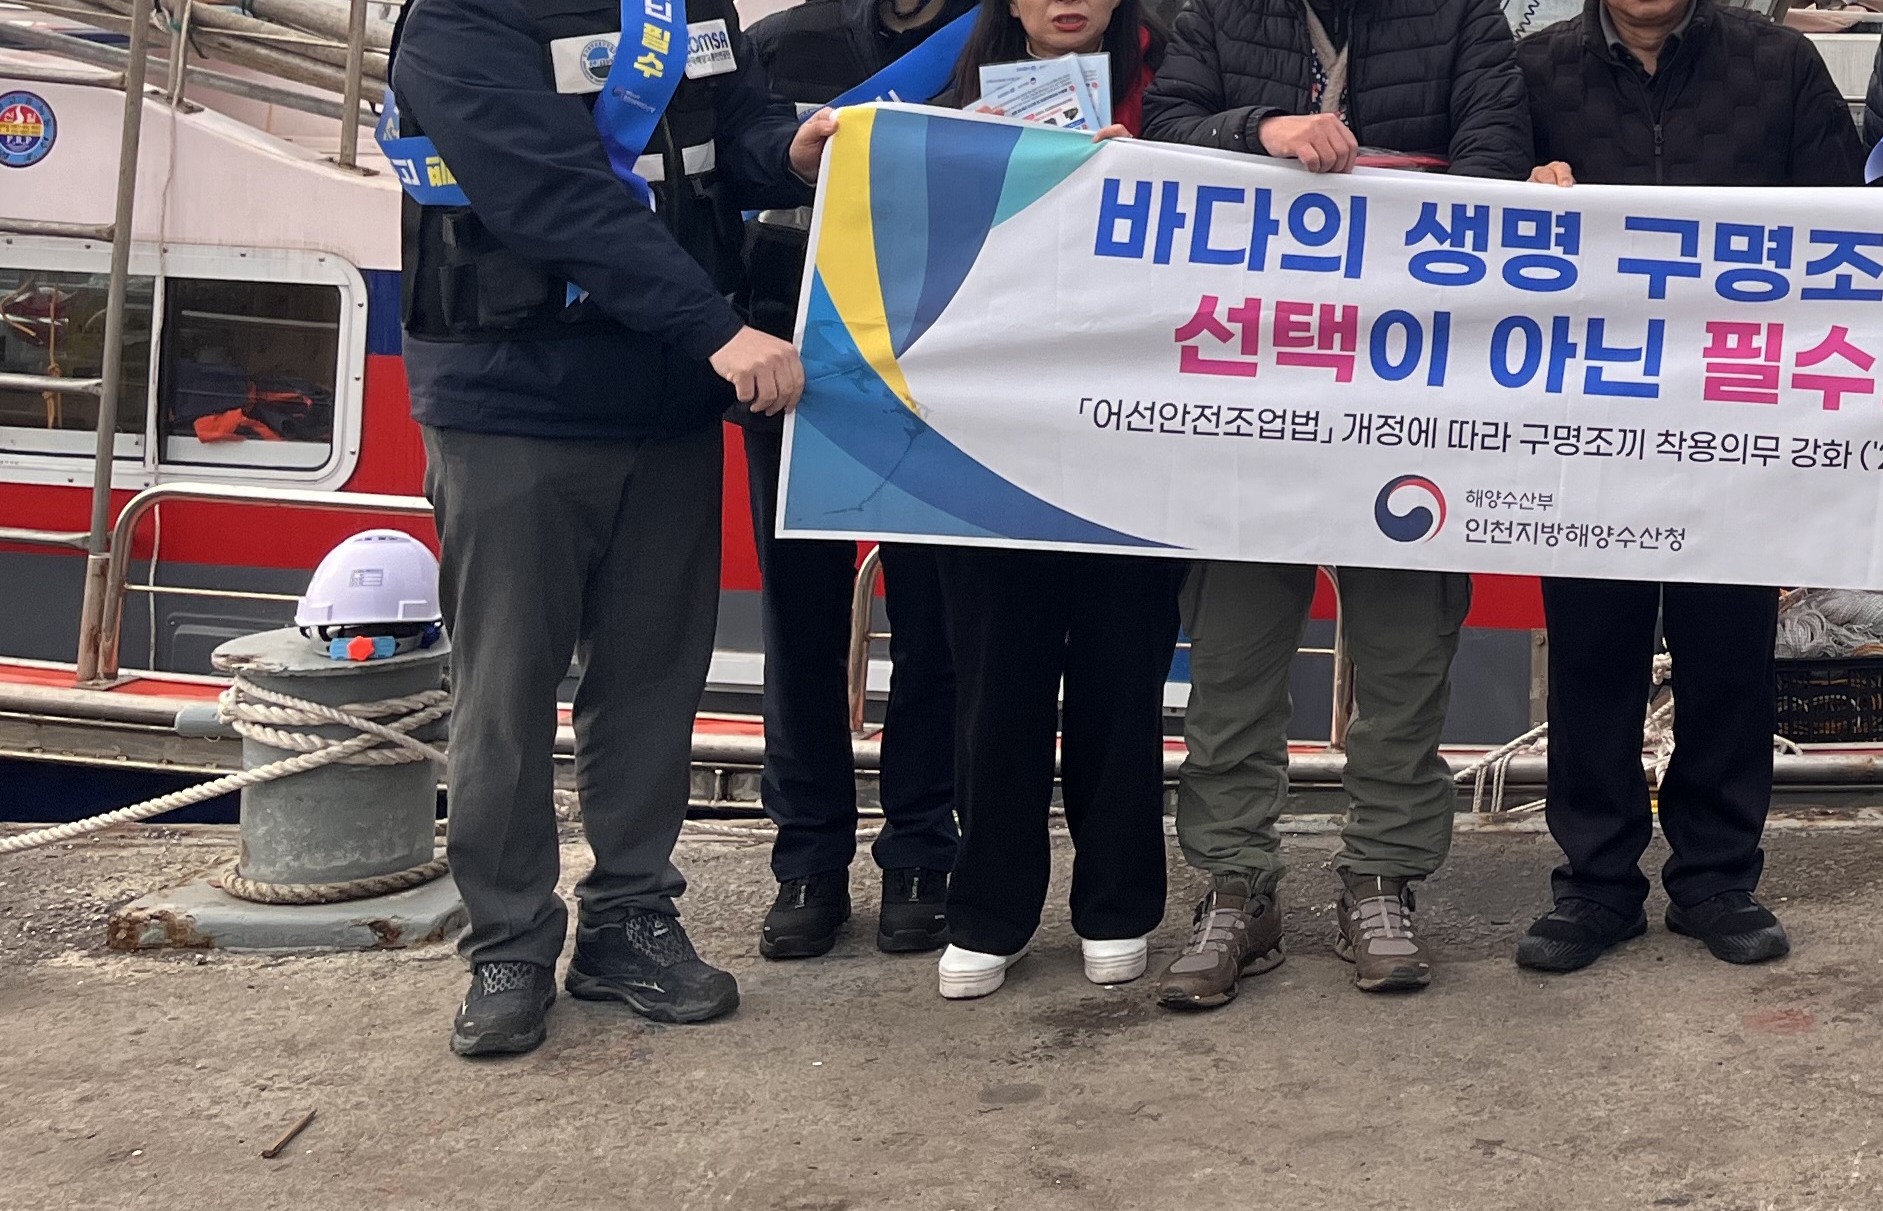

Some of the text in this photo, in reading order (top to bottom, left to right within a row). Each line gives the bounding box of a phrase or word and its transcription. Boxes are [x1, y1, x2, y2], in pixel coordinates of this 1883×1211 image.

[633, 22, 671, 79] 필수
[687, 31, 729, 55] OMSA
[1093, 177, 1368, 279] 바다의
[1404, 199, 1582, 293] 생명
[1174, 293, 1453, 388] 선택이
[1490, 313, 1666, 400] 아닌
[1077, 397, 1333, 445] 「어선안전조업법」
[1341, 412, 1438, 452] 개정에
[1447, 418, 1511, 455] 따라
[1519, 422, 1646, 462] 구명조끼
[1655, 428, 1780, 468] 착용의무
[1791, 435, 1853, 472] 강화
[1464, 487, 1554, 512] 해양수산부
[1464, 517, 1687, 552] 인천지방해양수산청
